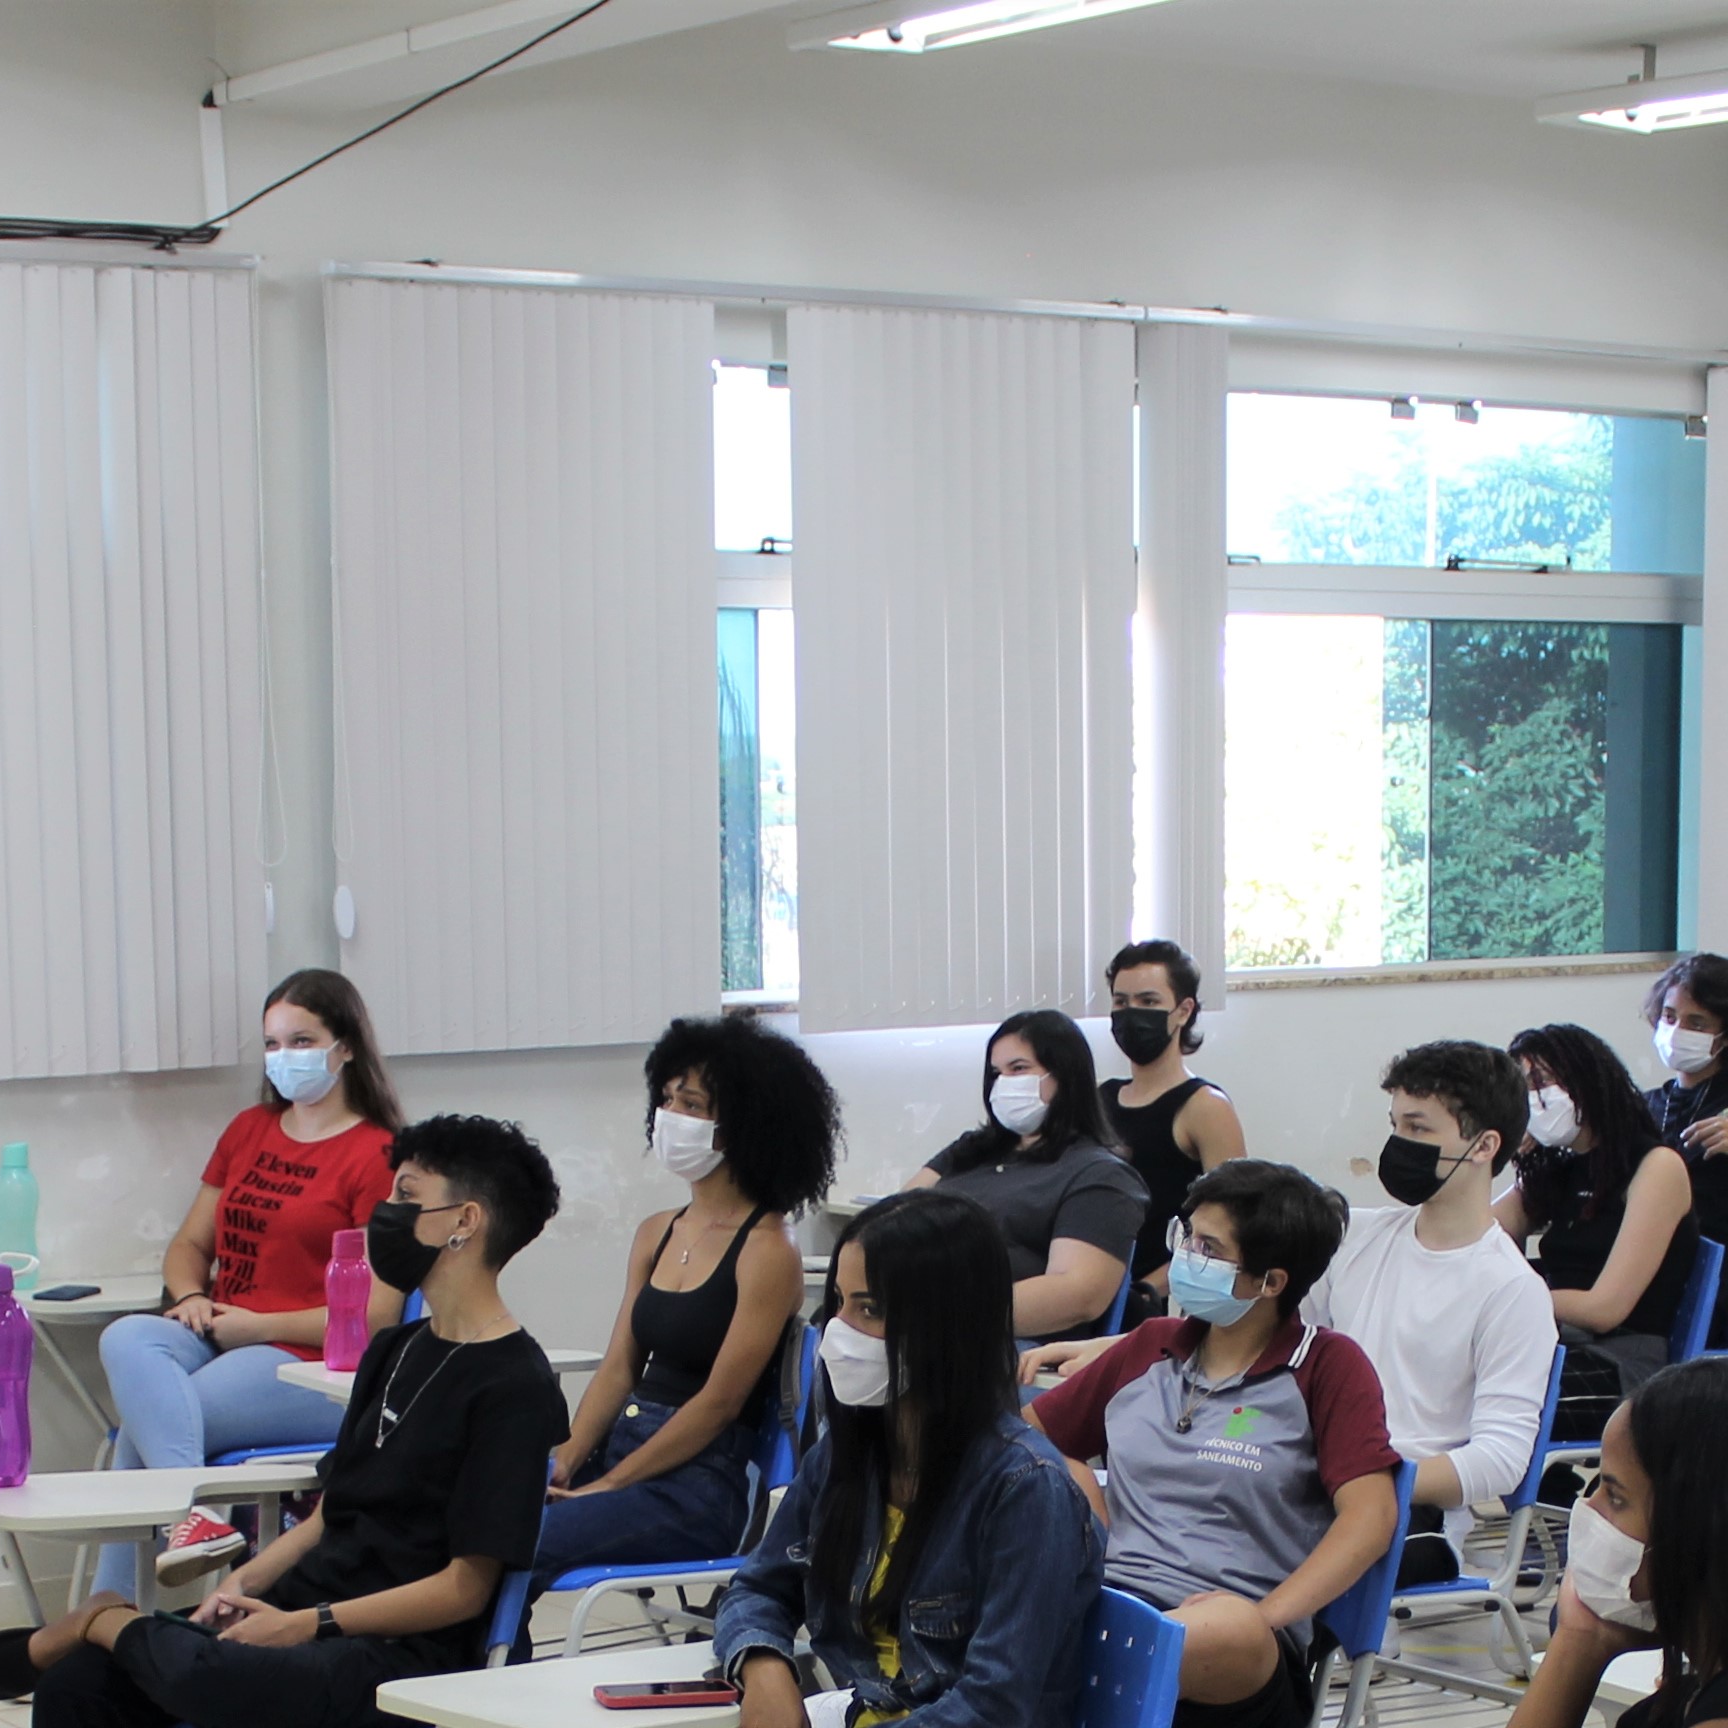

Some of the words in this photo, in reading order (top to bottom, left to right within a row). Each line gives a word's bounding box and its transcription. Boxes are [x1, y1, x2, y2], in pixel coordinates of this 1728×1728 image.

[255, 1151, 319, 1180] Eleven
[241, 1170, 304, 1197] Dustin
[227, 1186, 284, 1211] Lucas
[224, 1207, 268, 1234] Mike
[224, 1231, 259, 1257] Max
[1196, 1449, 1263, 1473] SANEAMENTO
[1244, 1444, 1261, 1457] EM
